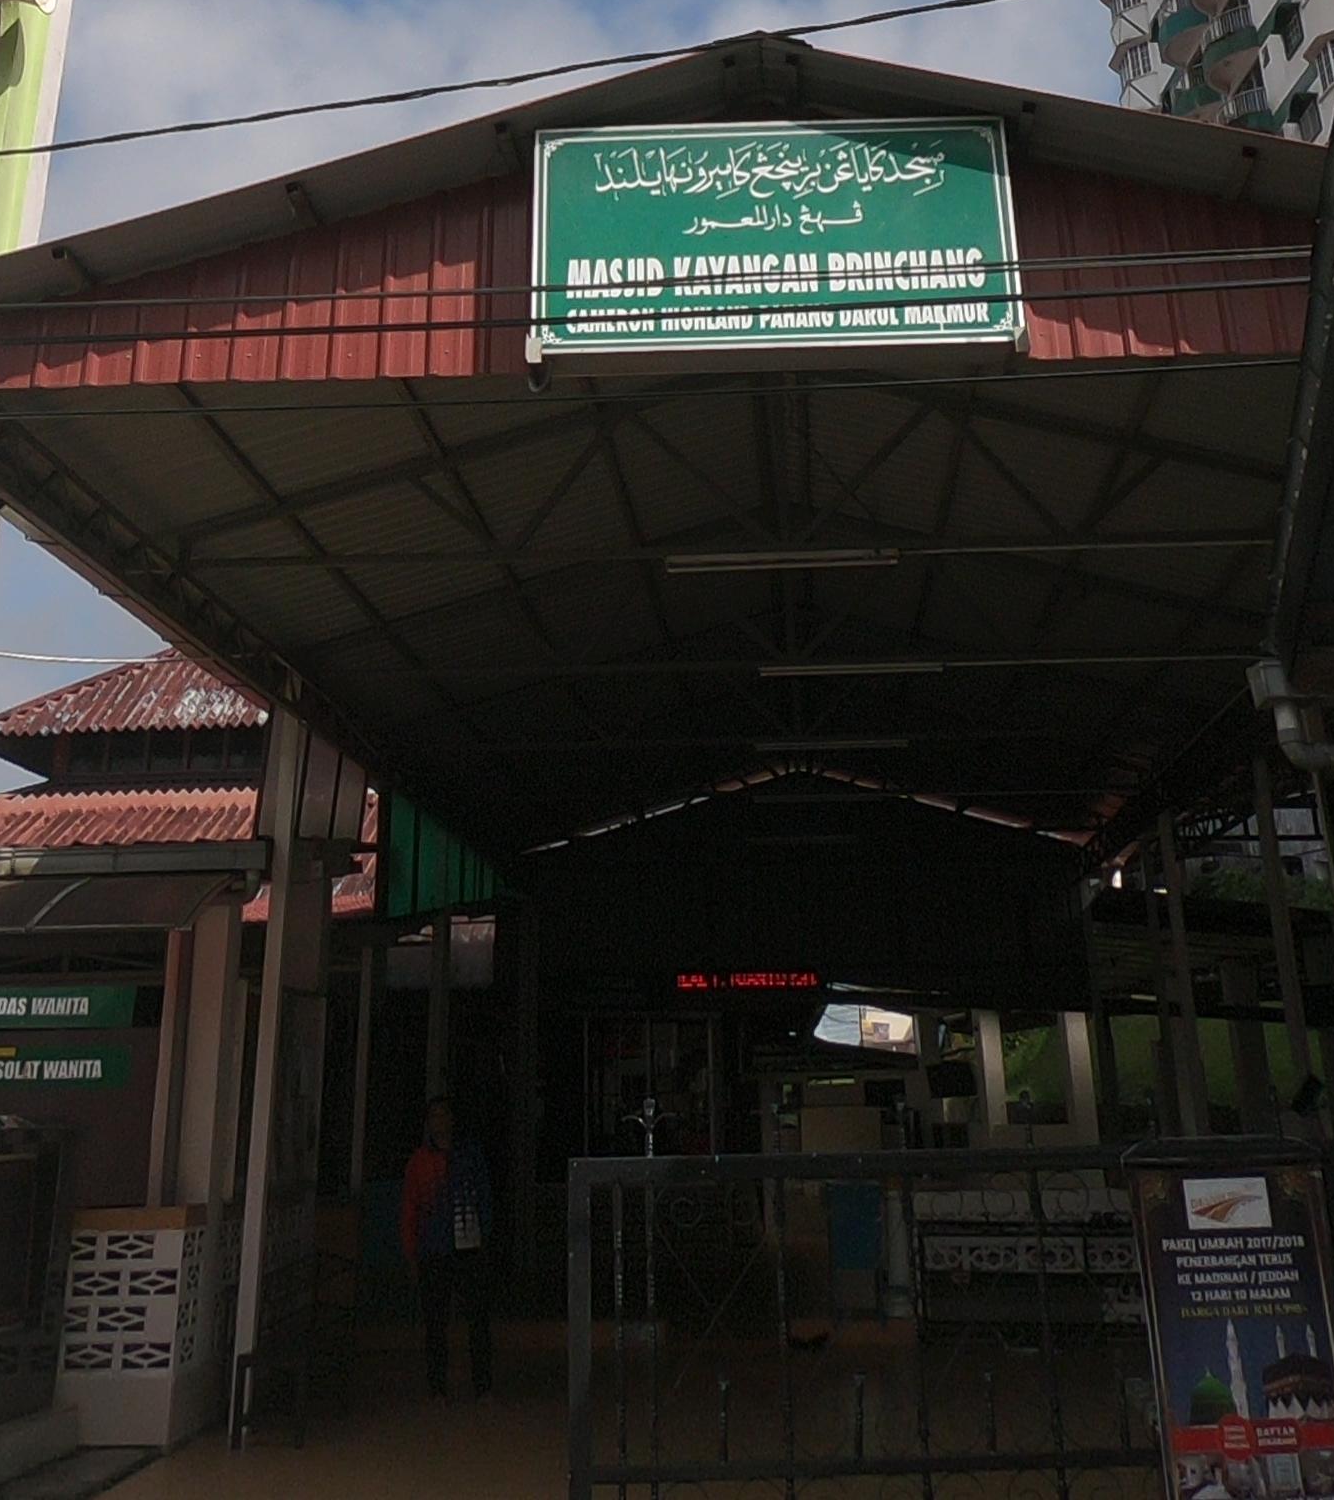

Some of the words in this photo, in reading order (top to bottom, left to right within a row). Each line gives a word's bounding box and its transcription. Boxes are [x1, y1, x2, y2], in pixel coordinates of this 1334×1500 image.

[566, 258, 665, 299] MASJID
[673, 253, 818, 296] KAYANGAN
[827, 248, 985, 293] BRINCHANG
[566, 308, 655, 334] CAMERON
[660, 305, 754, 332] HIGHLAND
[759, 303, 834, 330] PAHANG
[839, 302, 898, 327] DARUL
[904, 301, 989, 325] MAKMUR
[31, 996, 90, 1015] WANITA
[43, 1058, 102, 1079] WANITA
